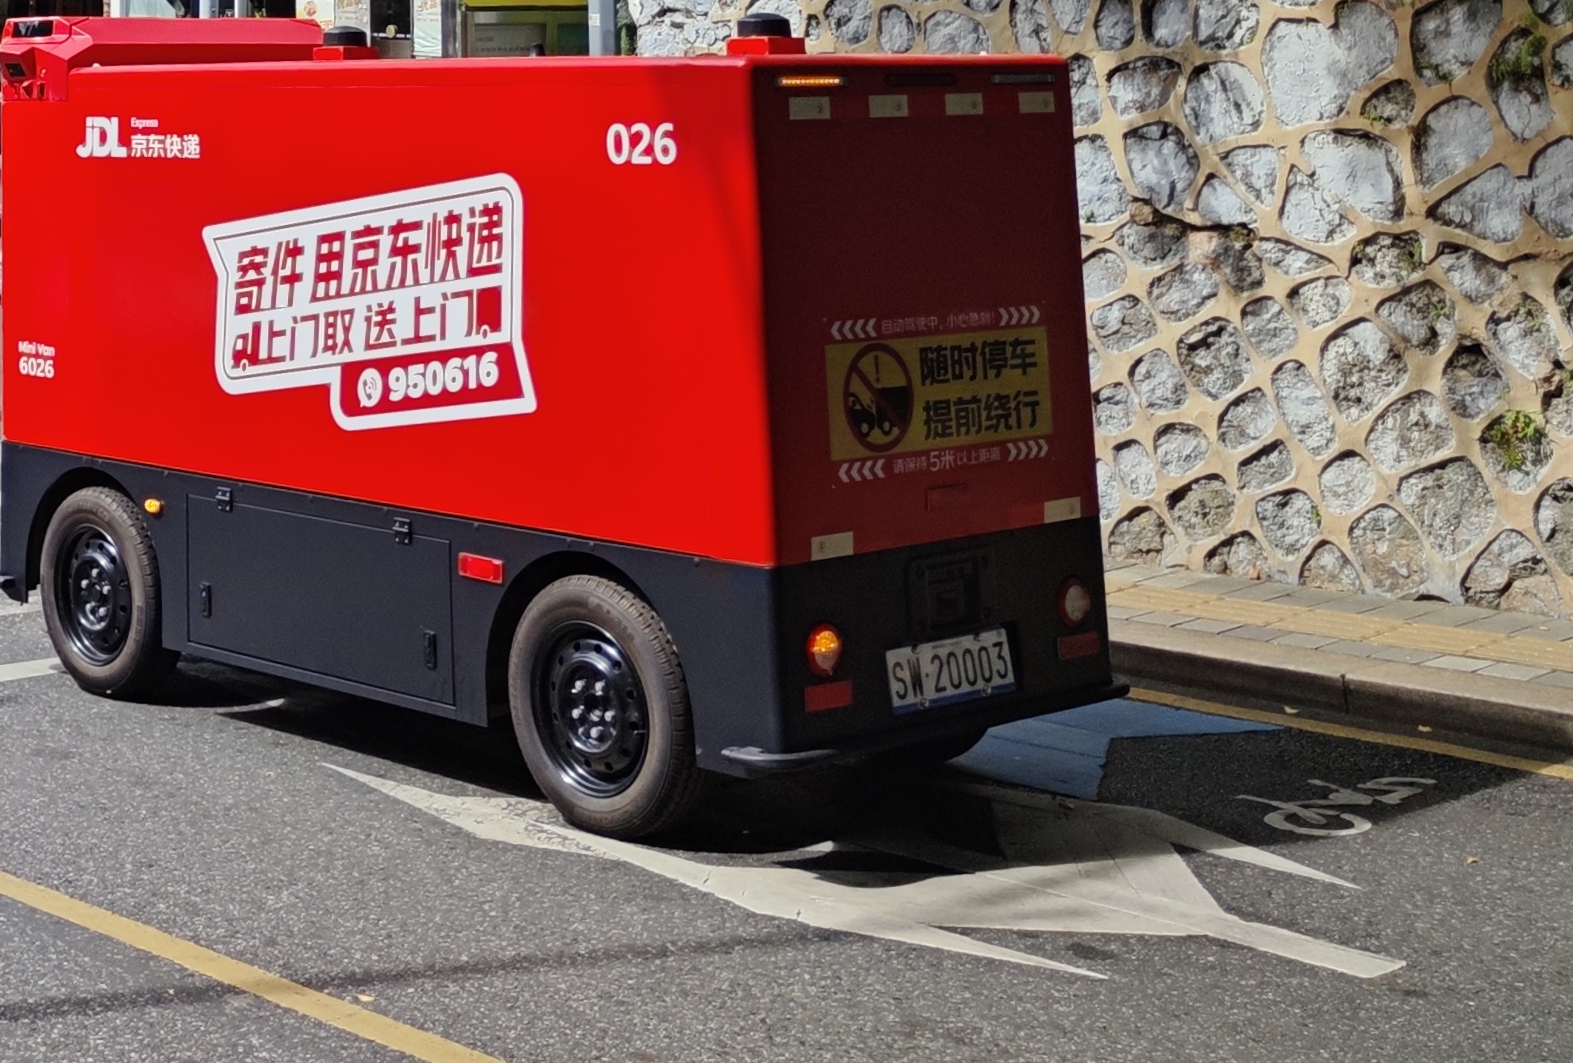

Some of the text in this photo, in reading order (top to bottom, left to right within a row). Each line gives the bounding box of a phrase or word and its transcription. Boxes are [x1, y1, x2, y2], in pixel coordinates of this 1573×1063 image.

[76, 116, 127, 158] JDL
[130, 134, 200, 158] 京东快递
[606, 122, 677, 165] 026
[18, 340, 55, 357] Mini Van
[18, 356, 55, 379] 6026
[919, 337, 1038, 386] 随时停车
[388, 351, 498, 402] 950616
[922, 390, 1041, 441] 提前绕行
